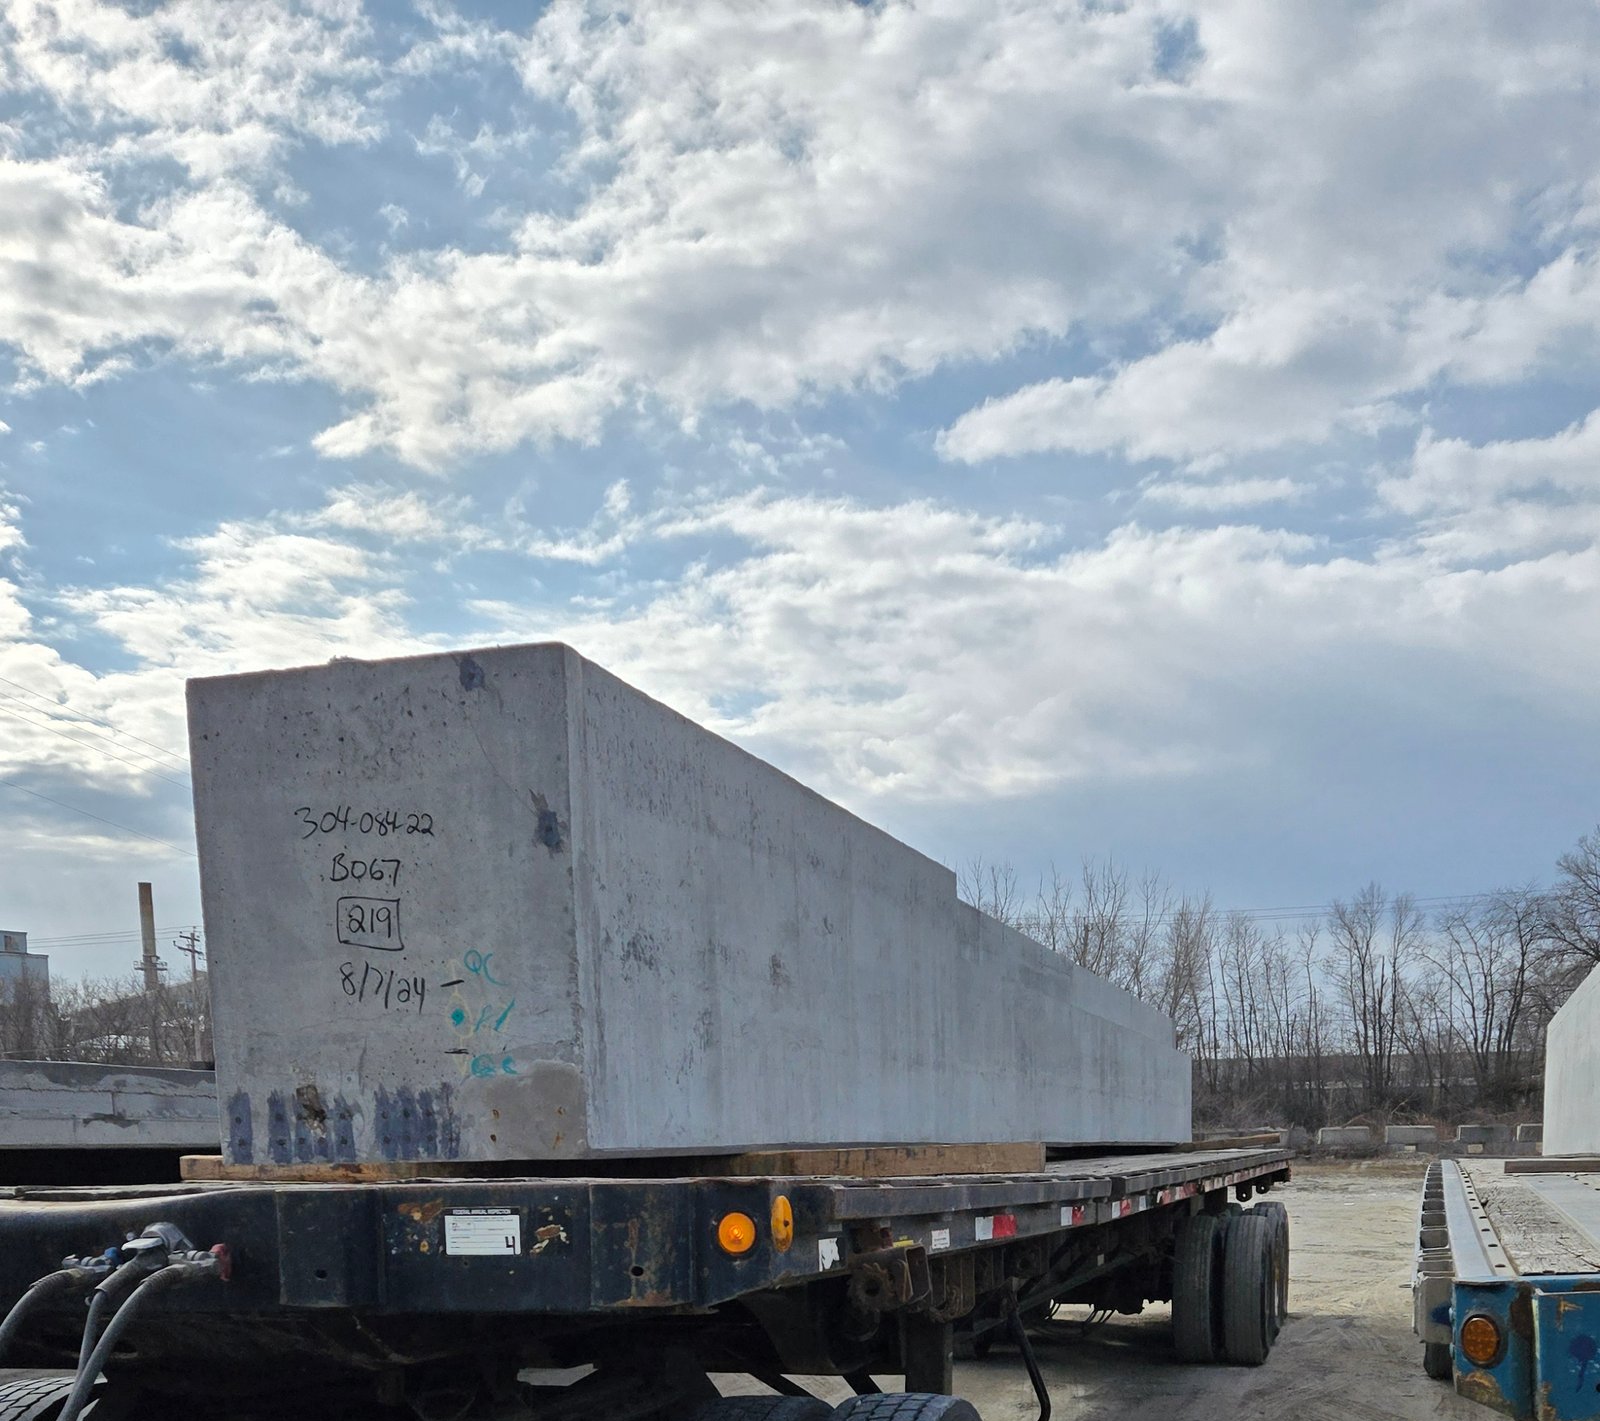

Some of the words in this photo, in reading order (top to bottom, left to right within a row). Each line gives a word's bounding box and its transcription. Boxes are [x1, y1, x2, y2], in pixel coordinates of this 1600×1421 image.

[330, 852, 401, 887] B067
[348, 904, 392, 938] 219
[338, 960, 426, 1015] 8/7/24
[504, 1235, 516, 1255] 4
